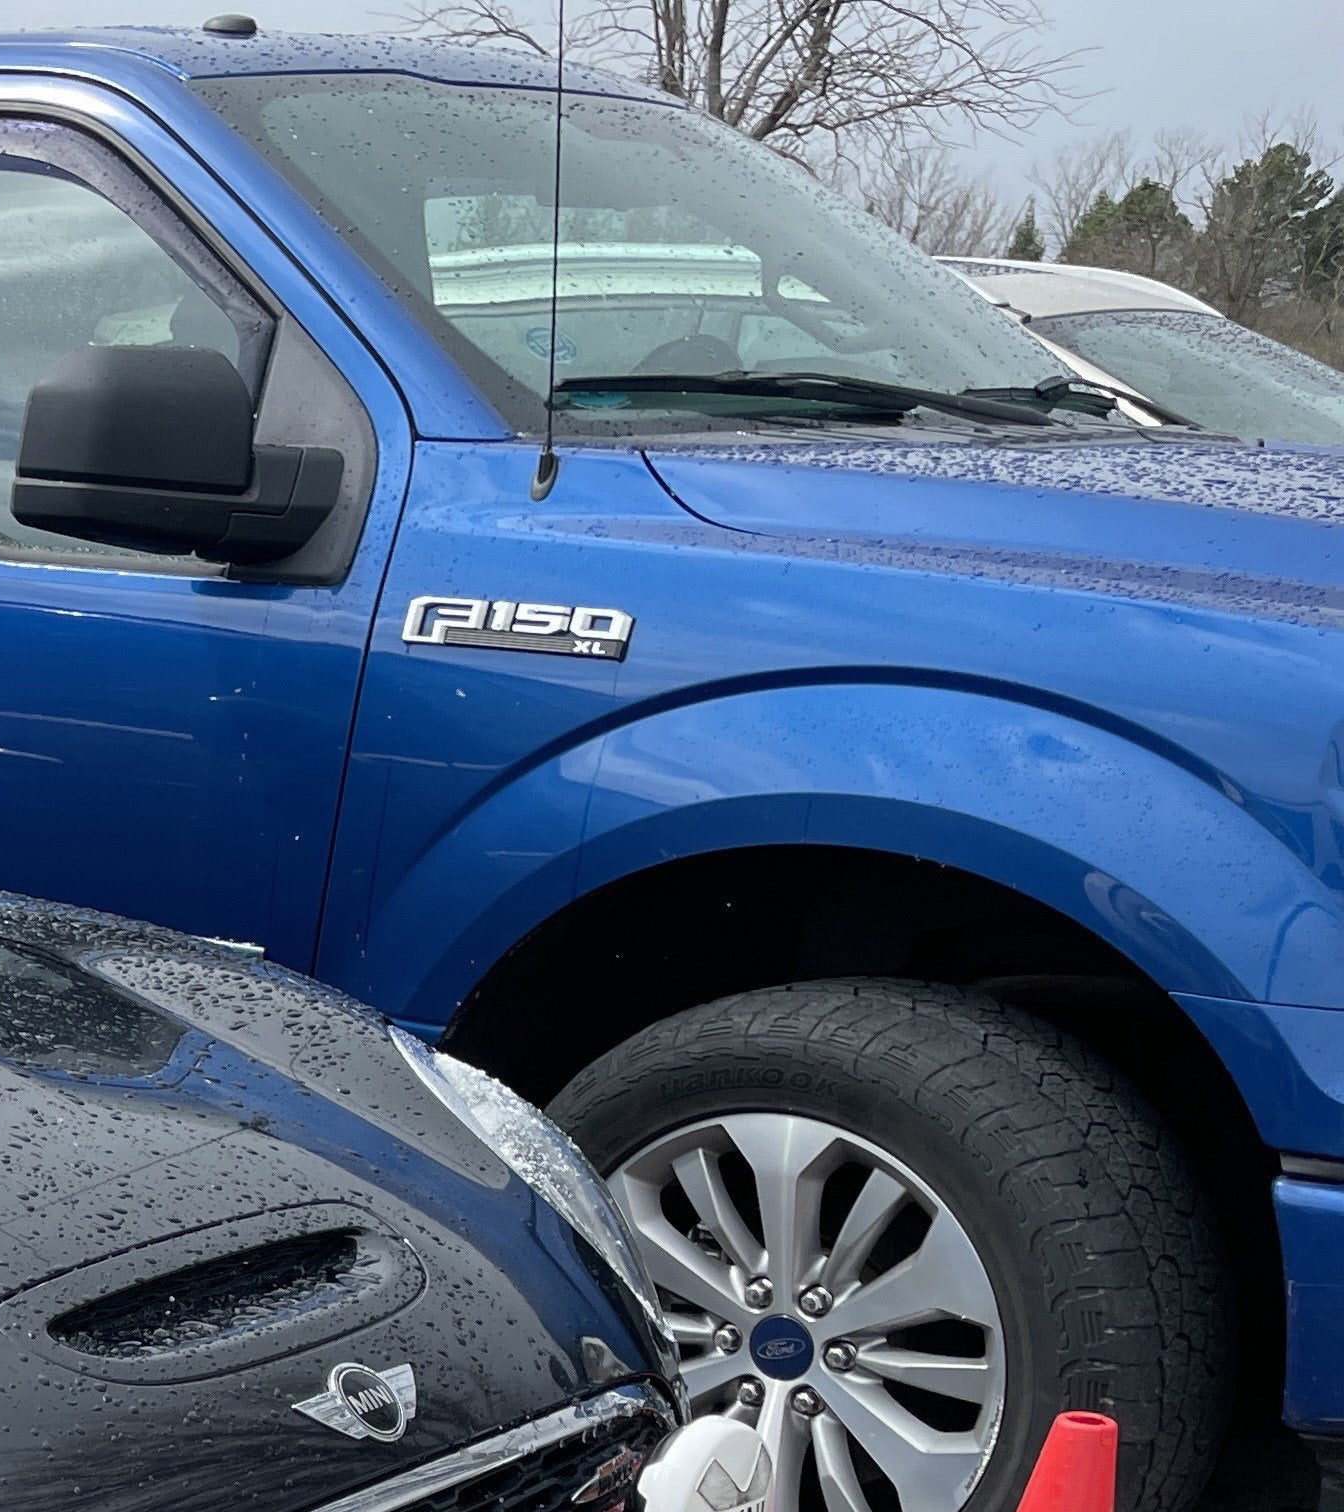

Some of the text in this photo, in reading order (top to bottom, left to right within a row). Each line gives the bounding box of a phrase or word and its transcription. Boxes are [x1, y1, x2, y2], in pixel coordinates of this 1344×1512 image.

[402, 596, 633, 644] F150
[572, 640, 606, 655] XL
[347, 1384, 394, 1415] MINI
